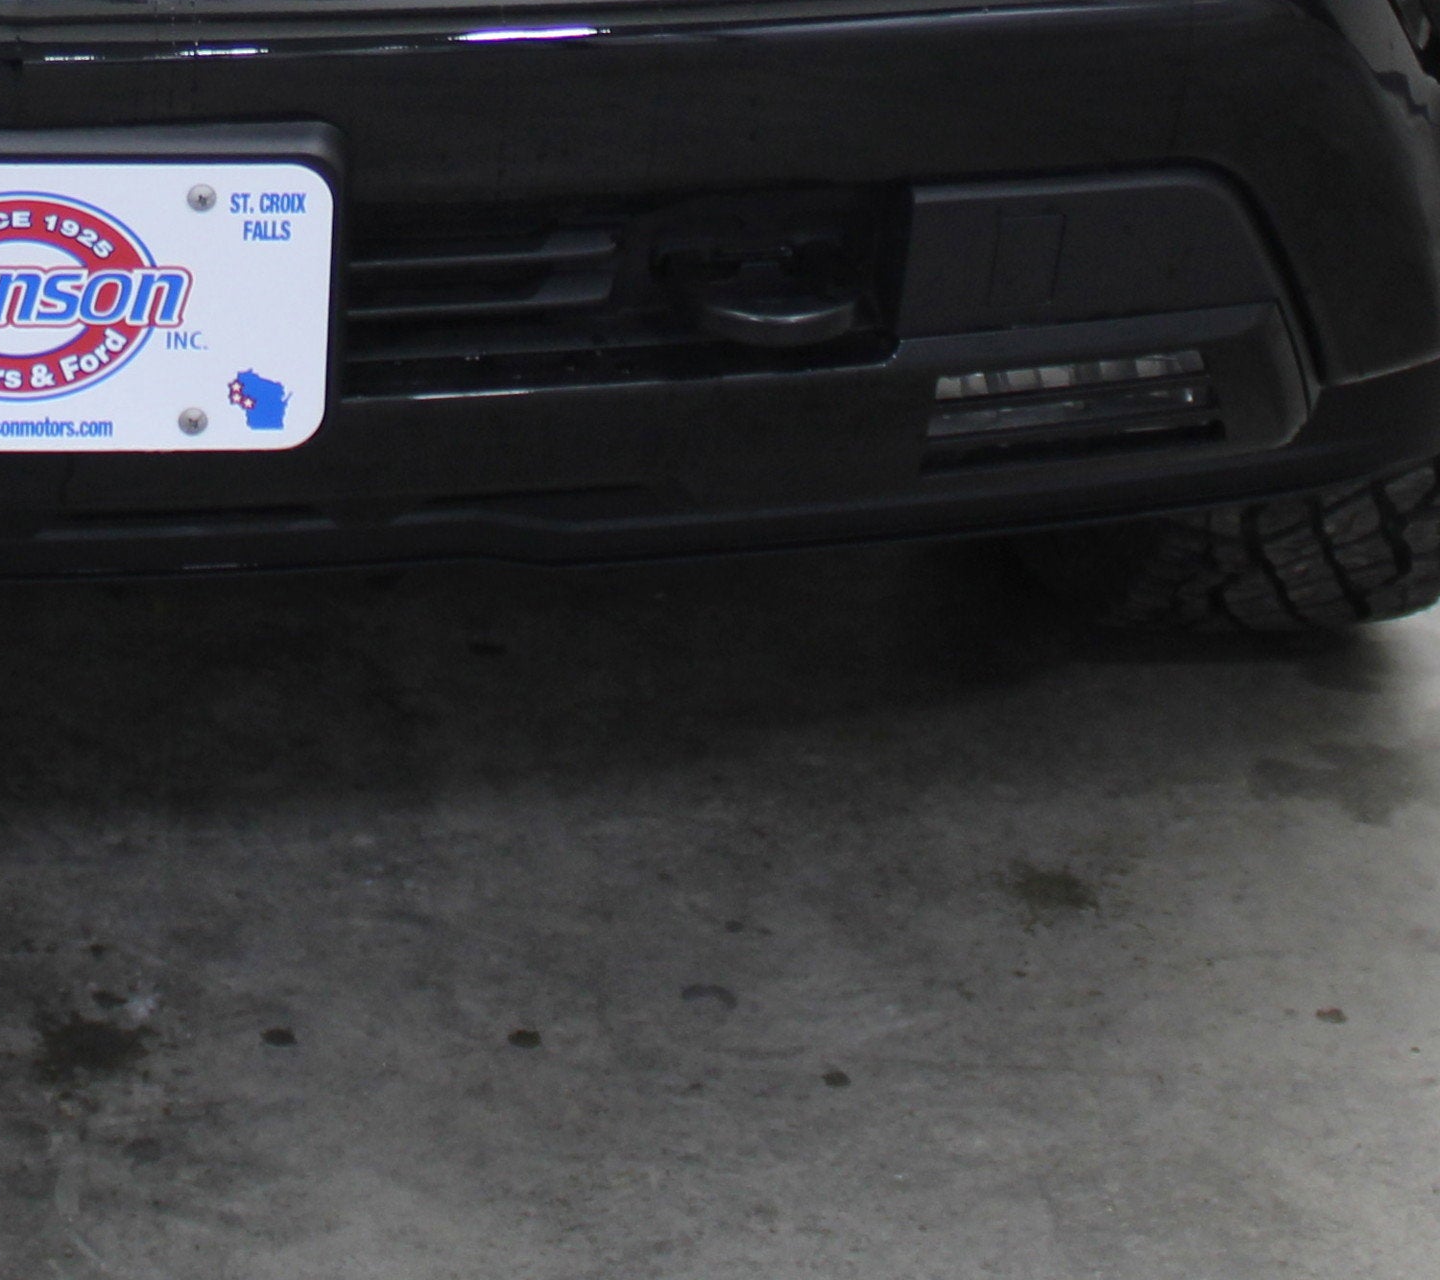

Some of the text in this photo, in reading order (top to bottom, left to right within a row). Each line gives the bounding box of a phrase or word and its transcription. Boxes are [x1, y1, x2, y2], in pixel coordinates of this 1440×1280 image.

[230, 192, 307, 214] ST. CROIX
[44, 215, 115, 259] 1925
[243, 220, 291, 241] FALLS
[166, 330, 208, 350] INC.
[30, 363, 56, 388] &
[58, 328, 127, 383] Ford
